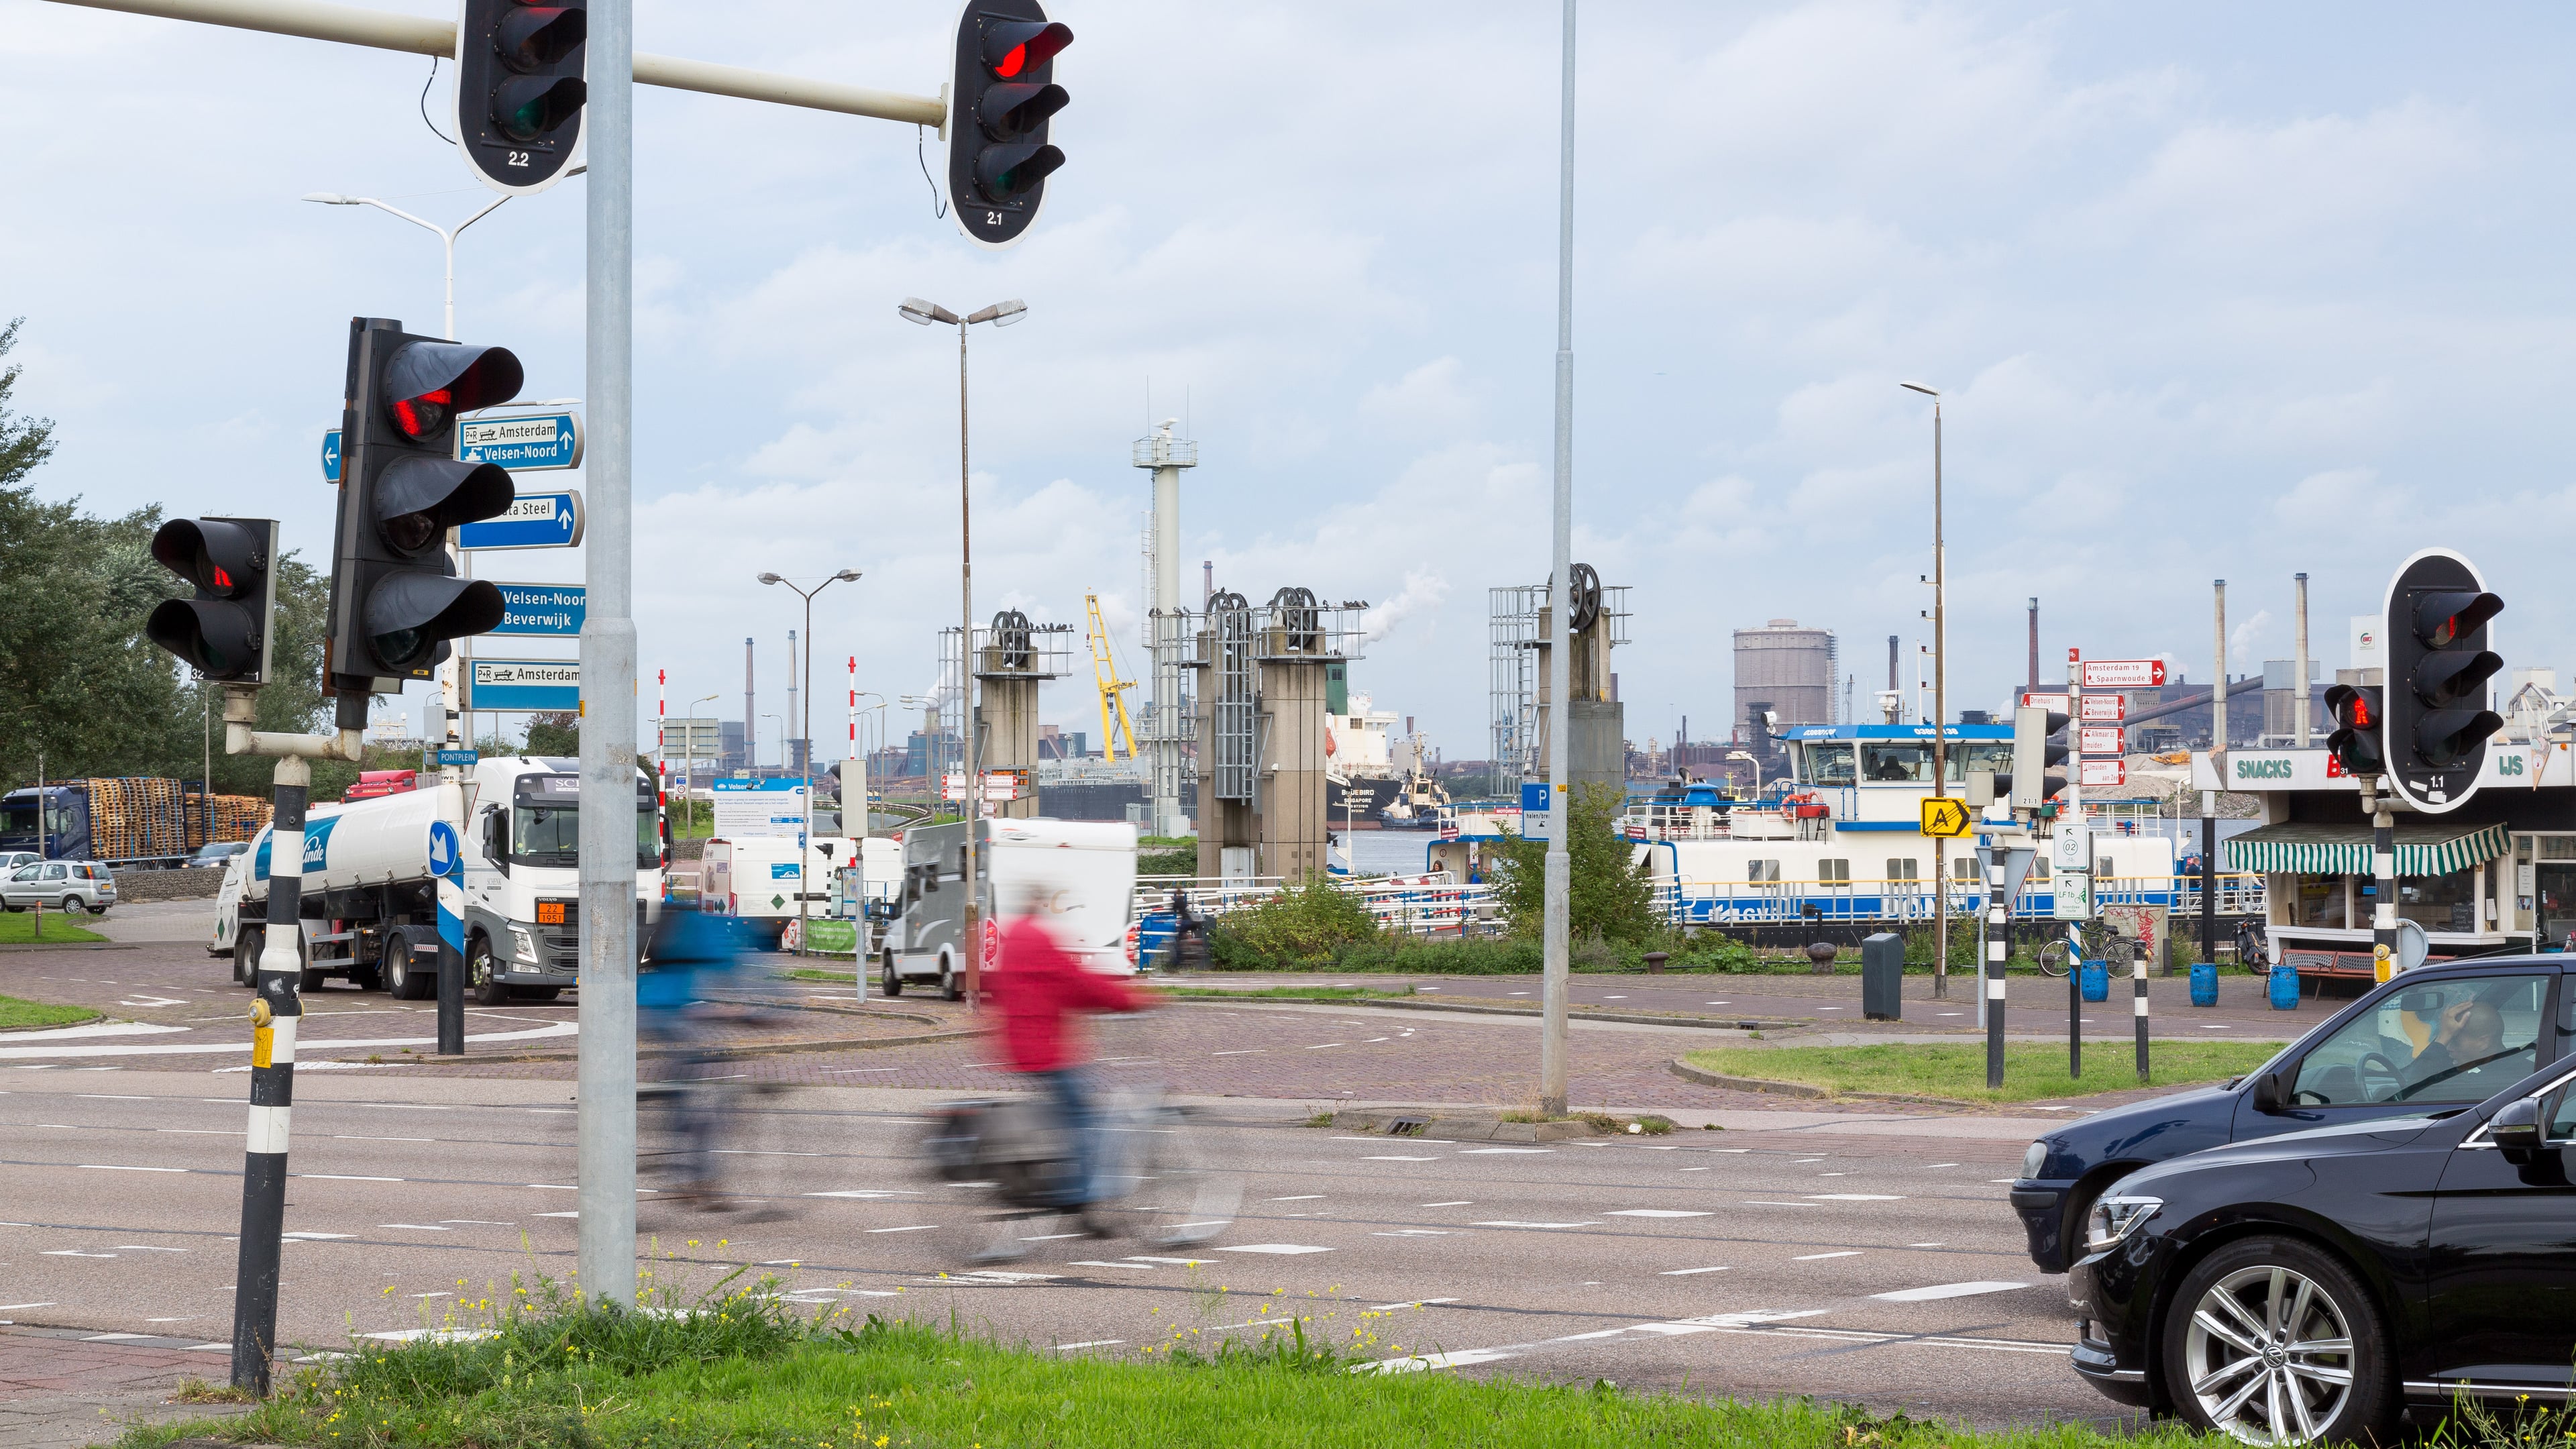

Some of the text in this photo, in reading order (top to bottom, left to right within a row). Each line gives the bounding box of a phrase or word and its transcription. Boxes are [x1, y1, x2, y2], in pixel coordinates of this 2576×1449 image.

[508, 151, 529, 166] 2.2
[987, 211, 1002, 225] 2.1
[499, 423, 555, 439] Amsterdam
[484, 443, 557, 460] Velsen-Noord
[523, 501, 549, 515] Steel
[503, 591, 586, 606] Velsen-Noor
[504, 611, 572, 629] Beverwijk
[517, 668, 580, 681] Amsterdam
[2096, 675, 2145, 684] Spaarnwoude
[2031, 696, 2051, 704] Driehuis
[2092, 708, 2112, 717] Beverwijk
[441, 753, 476, 762] PONTPLEIN
[2237, 759, 2292, 779] SNACKS
[2430, 775, 2444, 788] 1.1
[1933, 808, 1948, 827] A
[2065, 843, 2076, 851] 02
[780, 870, 800, 878] Linde
[547, 904, 557, 912] 22
